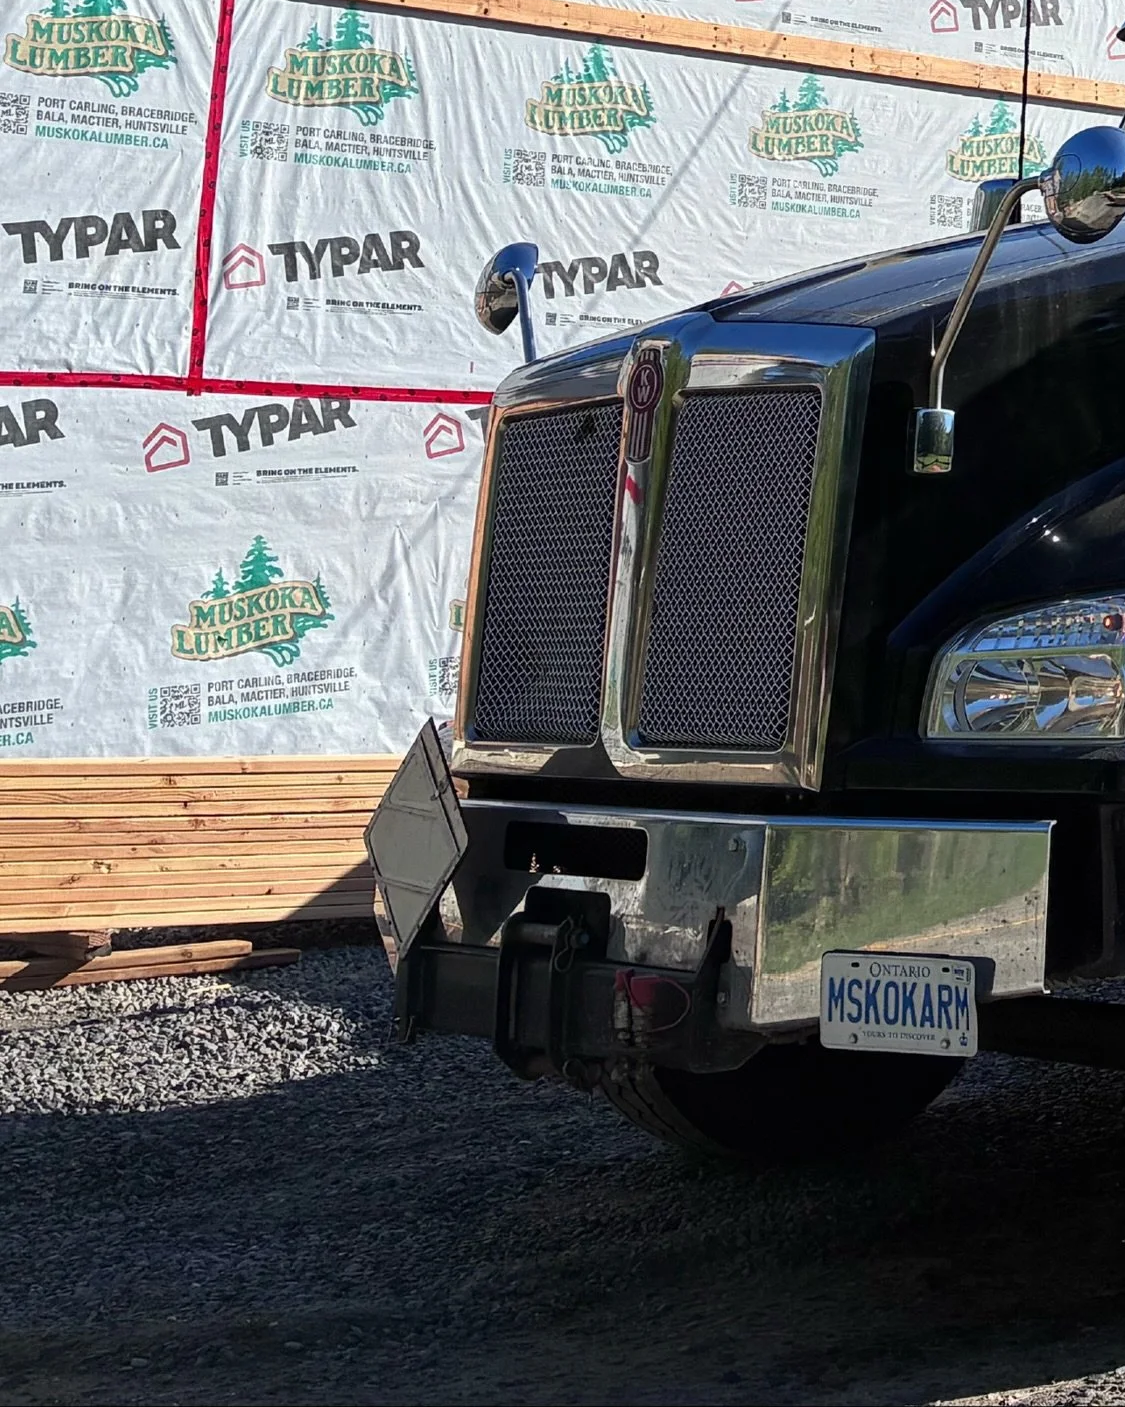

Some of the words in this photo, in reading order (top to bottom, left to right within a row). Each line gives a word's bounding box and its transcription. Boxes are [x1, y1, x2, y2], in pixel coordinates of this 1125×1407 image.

[31, 19, 161, 50] MUSKOKA
[10, 39, 130, 70] LUMBER
[288, 52, 404, 81] MUSKOKA
[271, 72, 375, 100] LUMBER
[36, 109, 68, 125] BALA,
[70, 113, 122, 130] MACTIER,
[124, 120, 188, 136] HUNTSVILLE
[37, 96, 67, 110] PORT
[69, 99, 119, 117] CARLING,
[121, 105, 198, 124] BRACEBRIDGE,
[527, 103, 620, 130] LUMBER
[35, 125, 169, 150] MUSKOKALUMBER.CA
[241, 119, 250, 131] US
[295, 125, 321, 139] PORT
[323, 128, 367, 144] CARLING,
[369, 133, 437, 151] BRACEBRIDGE,
[764, 112, 852, 138] MUSKOKA
[239, 132, 250, 158] VISIT
[294, 138, 323, 152] BALA,
[325, 141, 371, 157] MACTIER,
[372, 146, 429, 161] HUNTSVILLE
[505, 148, 513, 160] US
[750, 131, 832, 156] LUMBER
[293, 152, 412, 174] MUSKOKALUMBER.CA
[503, 161, 512, 184] VISIT
[1, 209, 182, 264] TYPAR
[267, 230, 425, 283] TYPAR
[536, 250, 664, 300] TYPAR
[67, 281, 97, 291] BRING
[97, 282, 113, 292] ON
[113, 284, 130, 293] THE
[130, 285, 180, 297] ELEMENTS.
[191, 396, 358, 458] TYPAR
[255, 469, 283, 477] BRING
[283, 468, 297, 476] ON
[297, 467, 314, 476] THE
[314, 465, 360, 475] ELEMENTS.
[15, 480, 67, 490] ELEMENTS.
[193, 585, 319, 629] MUSKOKA
[175, 613, 290, 656] LUMBER
[207, 679, 234, 693] PORT
[237, 675, 284, 690] CARLING,
[286, 667, 358, 684] BRACEBRIDGE,
[149, 688, 158, 702] US
[207, 693, 238, 707] BALA,
[240, 688, 289, 703] MACTIER,
[291, 682, 350, 698] HUNTSVILLE
[148, 703, 158, 730] VISIT
[207, 698, 334, 724] MUSKOKALUMBER.CA
[869, 961, 931, 978] ONTARIO
[828, 977, 970, 1031] MSKOKARM
